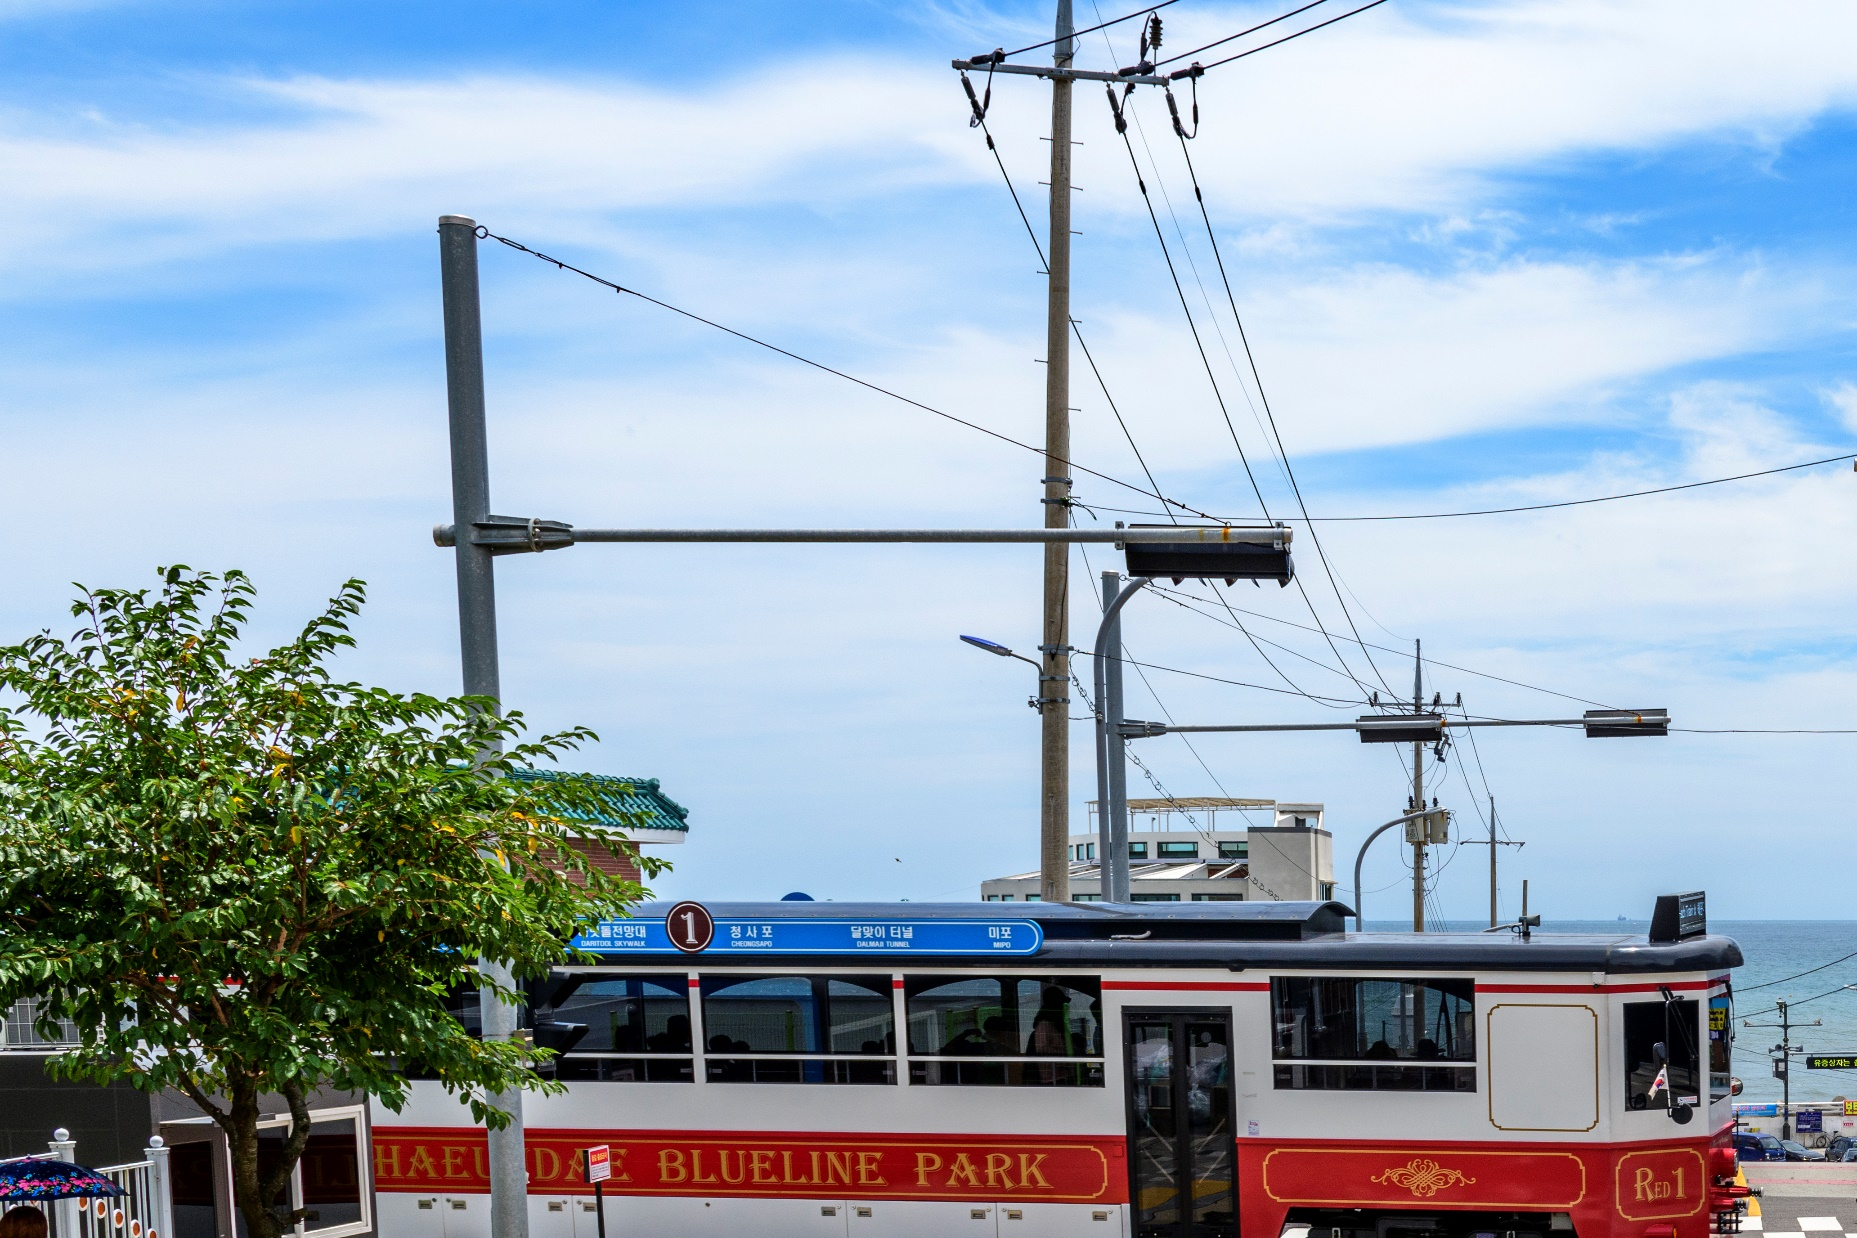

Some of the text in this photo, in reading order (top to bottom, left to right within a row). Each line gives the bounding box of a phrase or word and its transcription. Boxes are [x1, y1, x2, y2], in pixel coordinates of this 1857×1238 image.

[680, 911, 699, 944] 1
[850, 925, 914, 939] 달맞이 터널
[988, 926, 1012, 940] 미포
[614, 940, 646, 948] SKYWALK
[731, 940, 773, 948] CHEONGSAPO
[856, 940, 885, 948] DALMAJI
[993, 941, 1011, 949] MIPO
[373, 1144, 634, 1182] HAEDAE
[657, 1148, 889, 1188] BLUELINE
[914, 1151, 1055, 1191] PARK
[1671, 1167, 1688, 1200] 1
